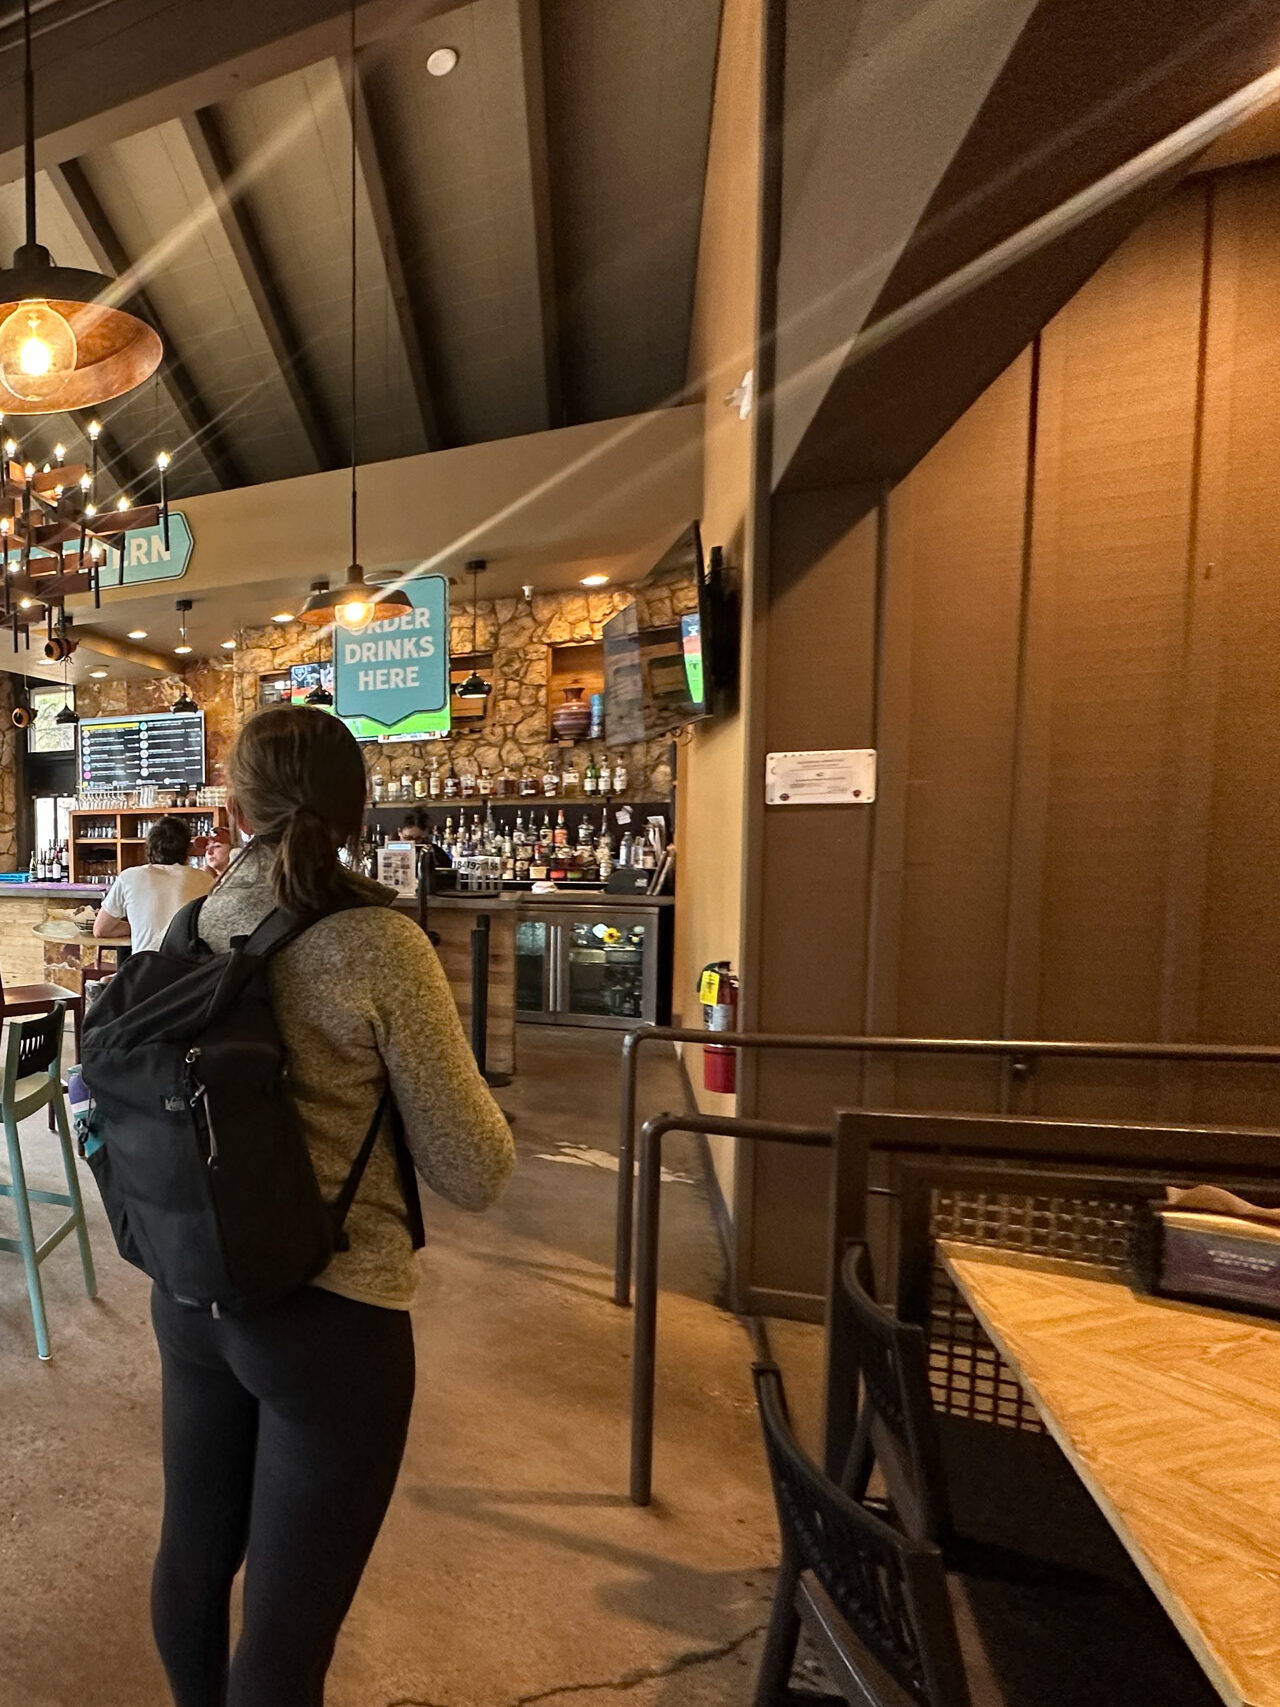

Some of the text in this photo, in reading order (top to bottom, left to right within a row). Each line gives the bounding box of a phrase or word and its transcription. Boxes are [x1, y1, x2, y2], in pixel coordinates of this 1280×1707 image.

[349, 607, 431, 635] RDER
[344, 636, 435, 664] DRINKS
[358, 666, 420, 691] HERE
